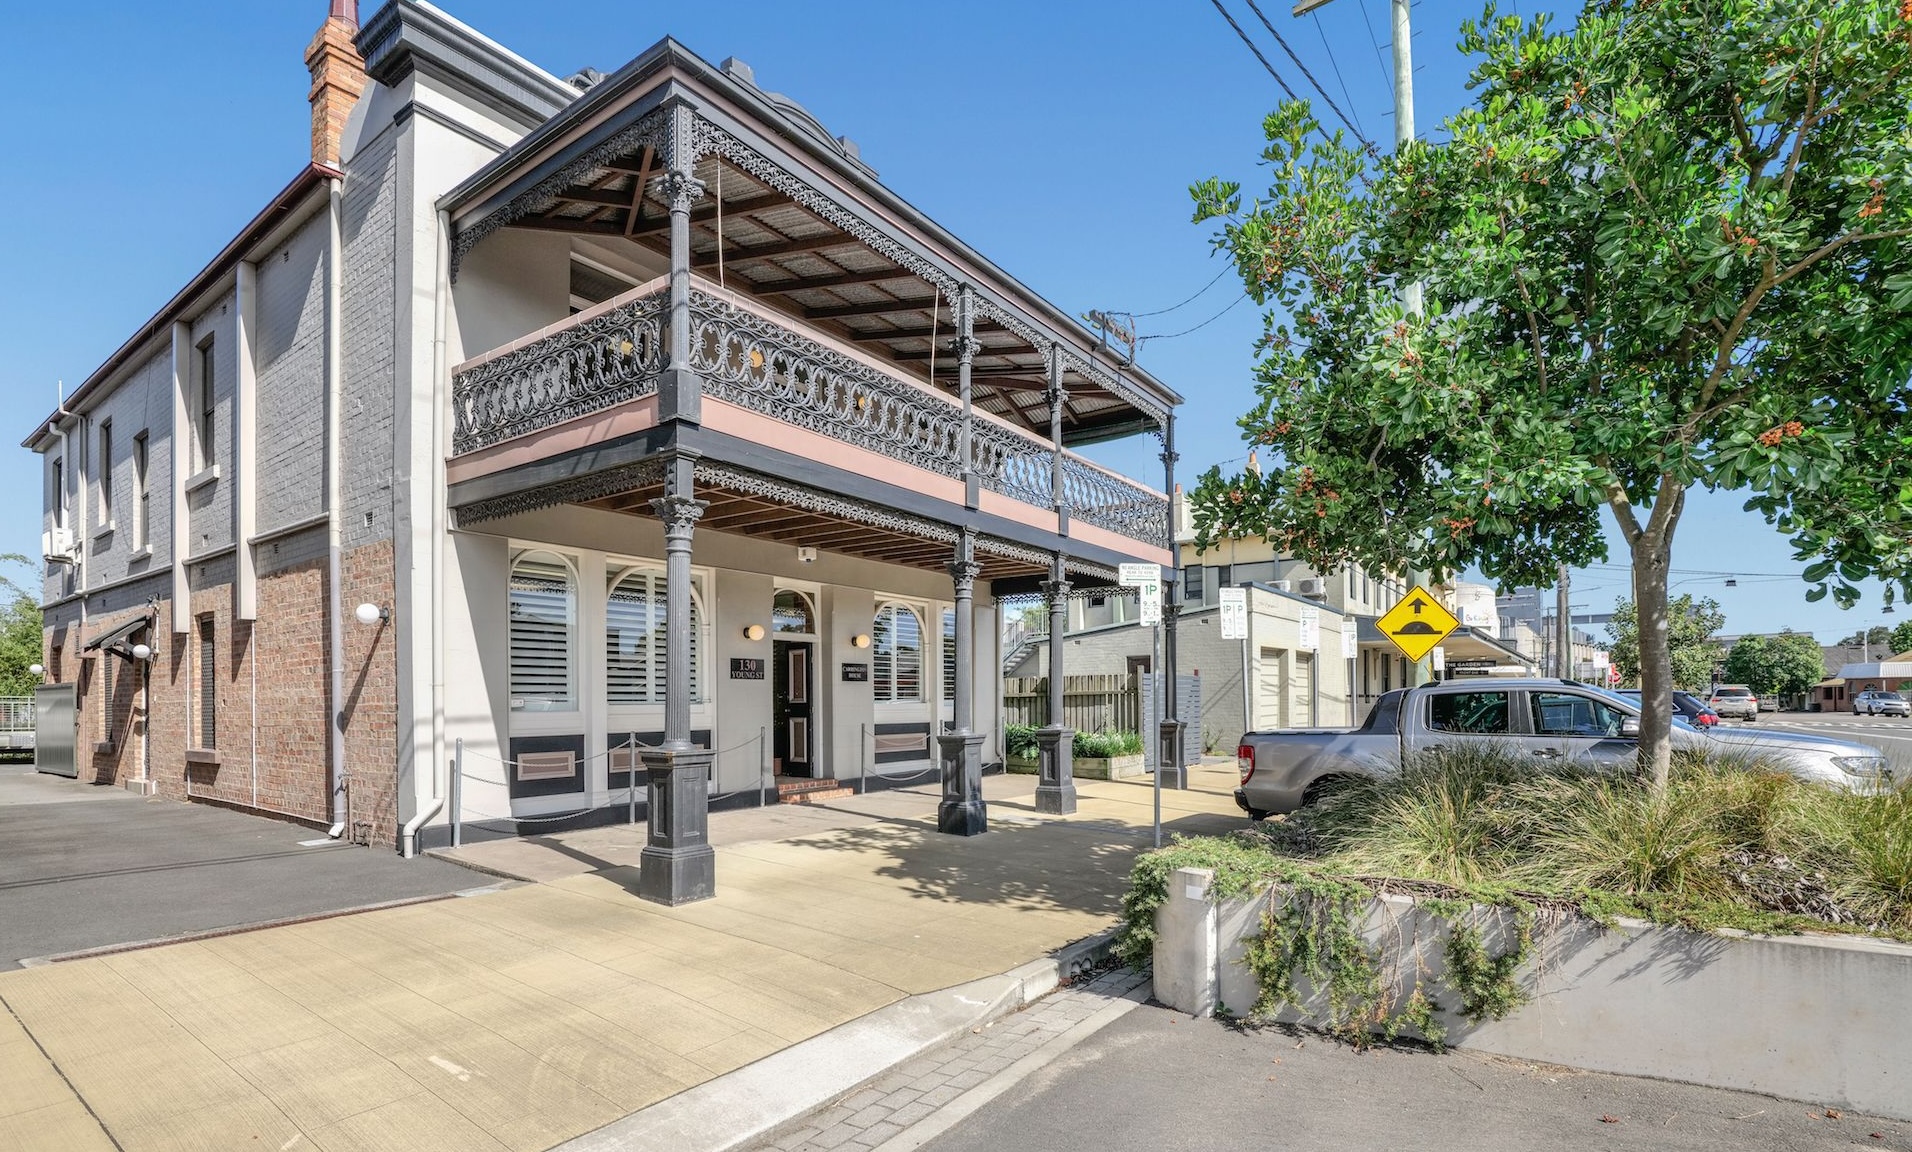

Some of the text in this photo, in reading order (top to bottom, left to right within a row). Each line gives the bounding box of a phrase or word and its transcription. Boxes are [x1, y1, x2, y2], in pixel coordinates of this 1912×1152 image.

[1145, 583, 1157, 595] 1P
[740, 660, 756, 671] 130
[732, 671, 755, 679] YOUNG
